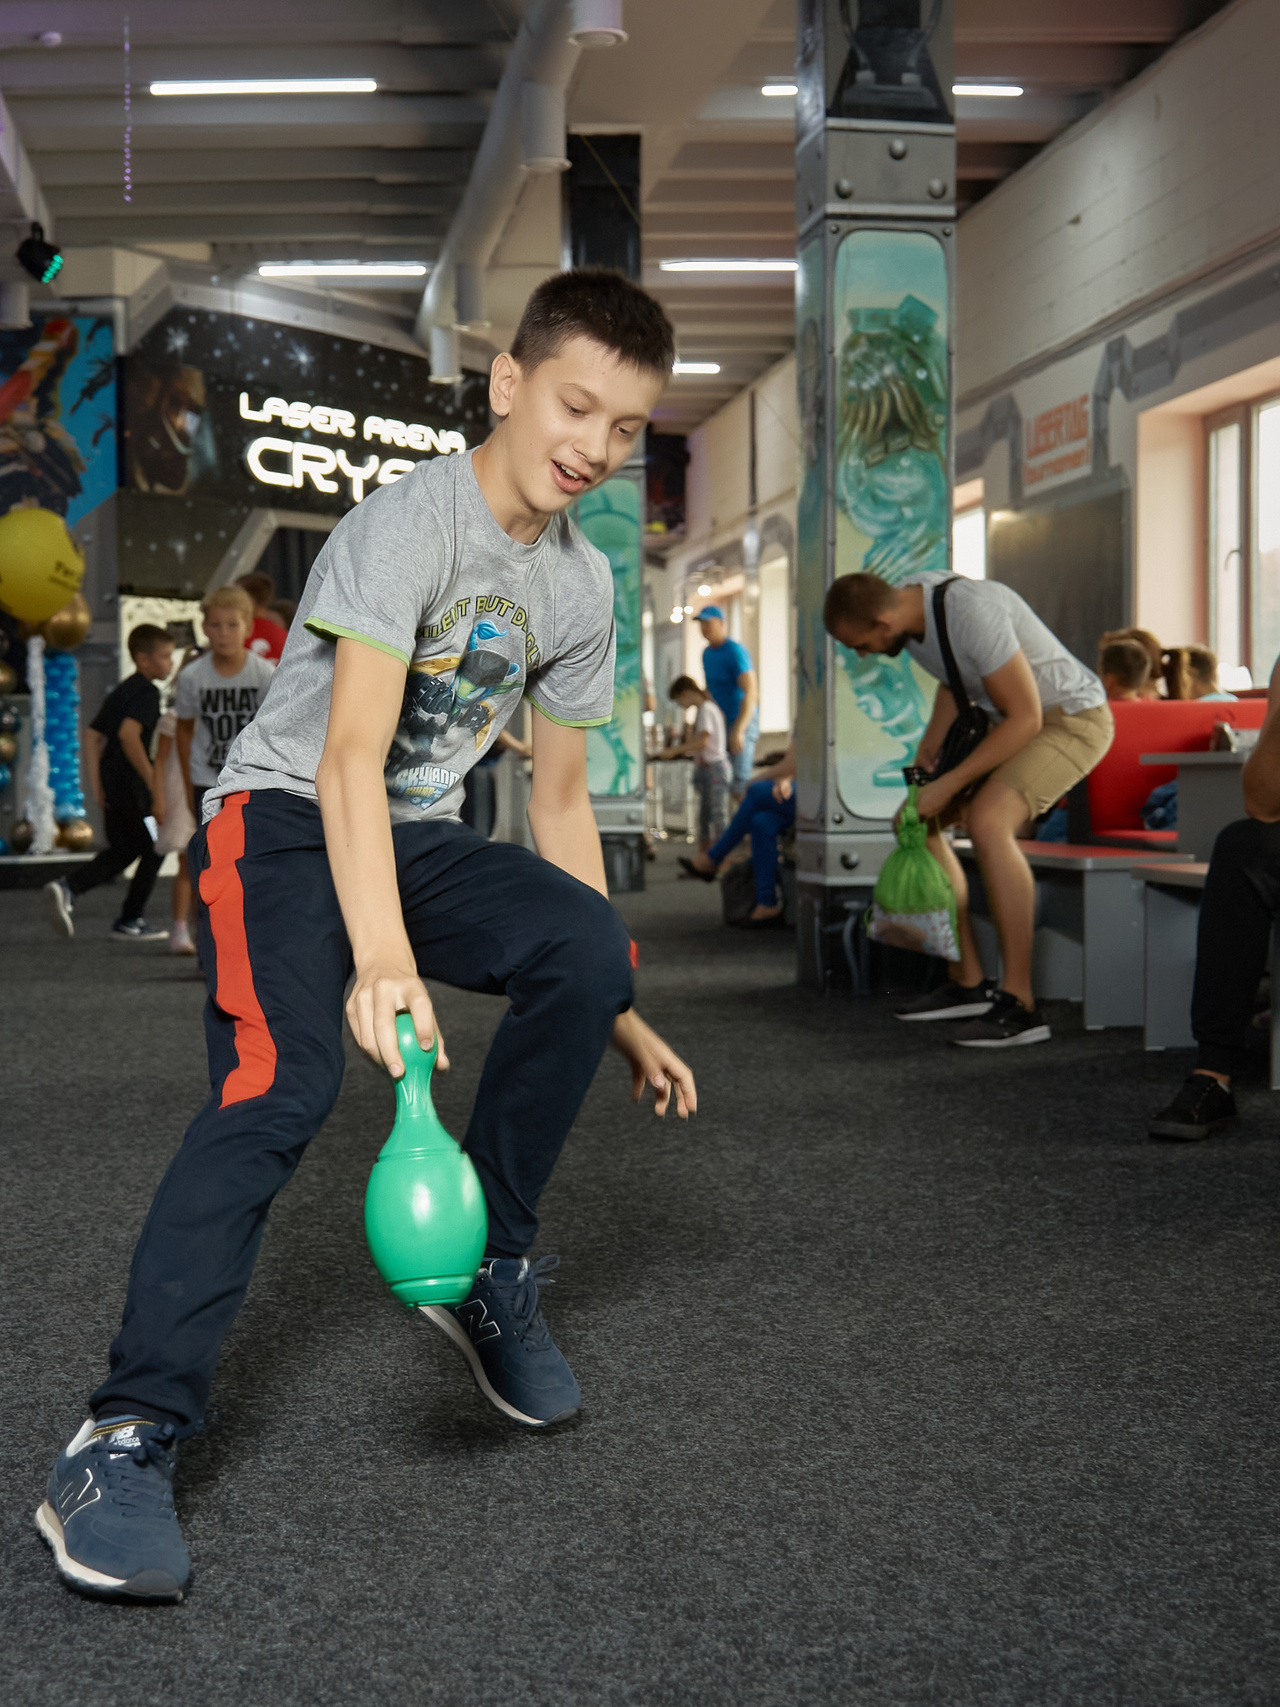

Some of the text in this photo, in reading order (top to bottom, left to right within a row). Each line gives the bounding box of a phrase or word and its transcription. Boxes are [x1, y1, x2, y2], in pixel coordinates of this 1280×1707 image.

[239, 391, 467, 455] LASER ARENA
[416, 597, 471, 638] ILENT
[475, 595, 515, 617] BUT
